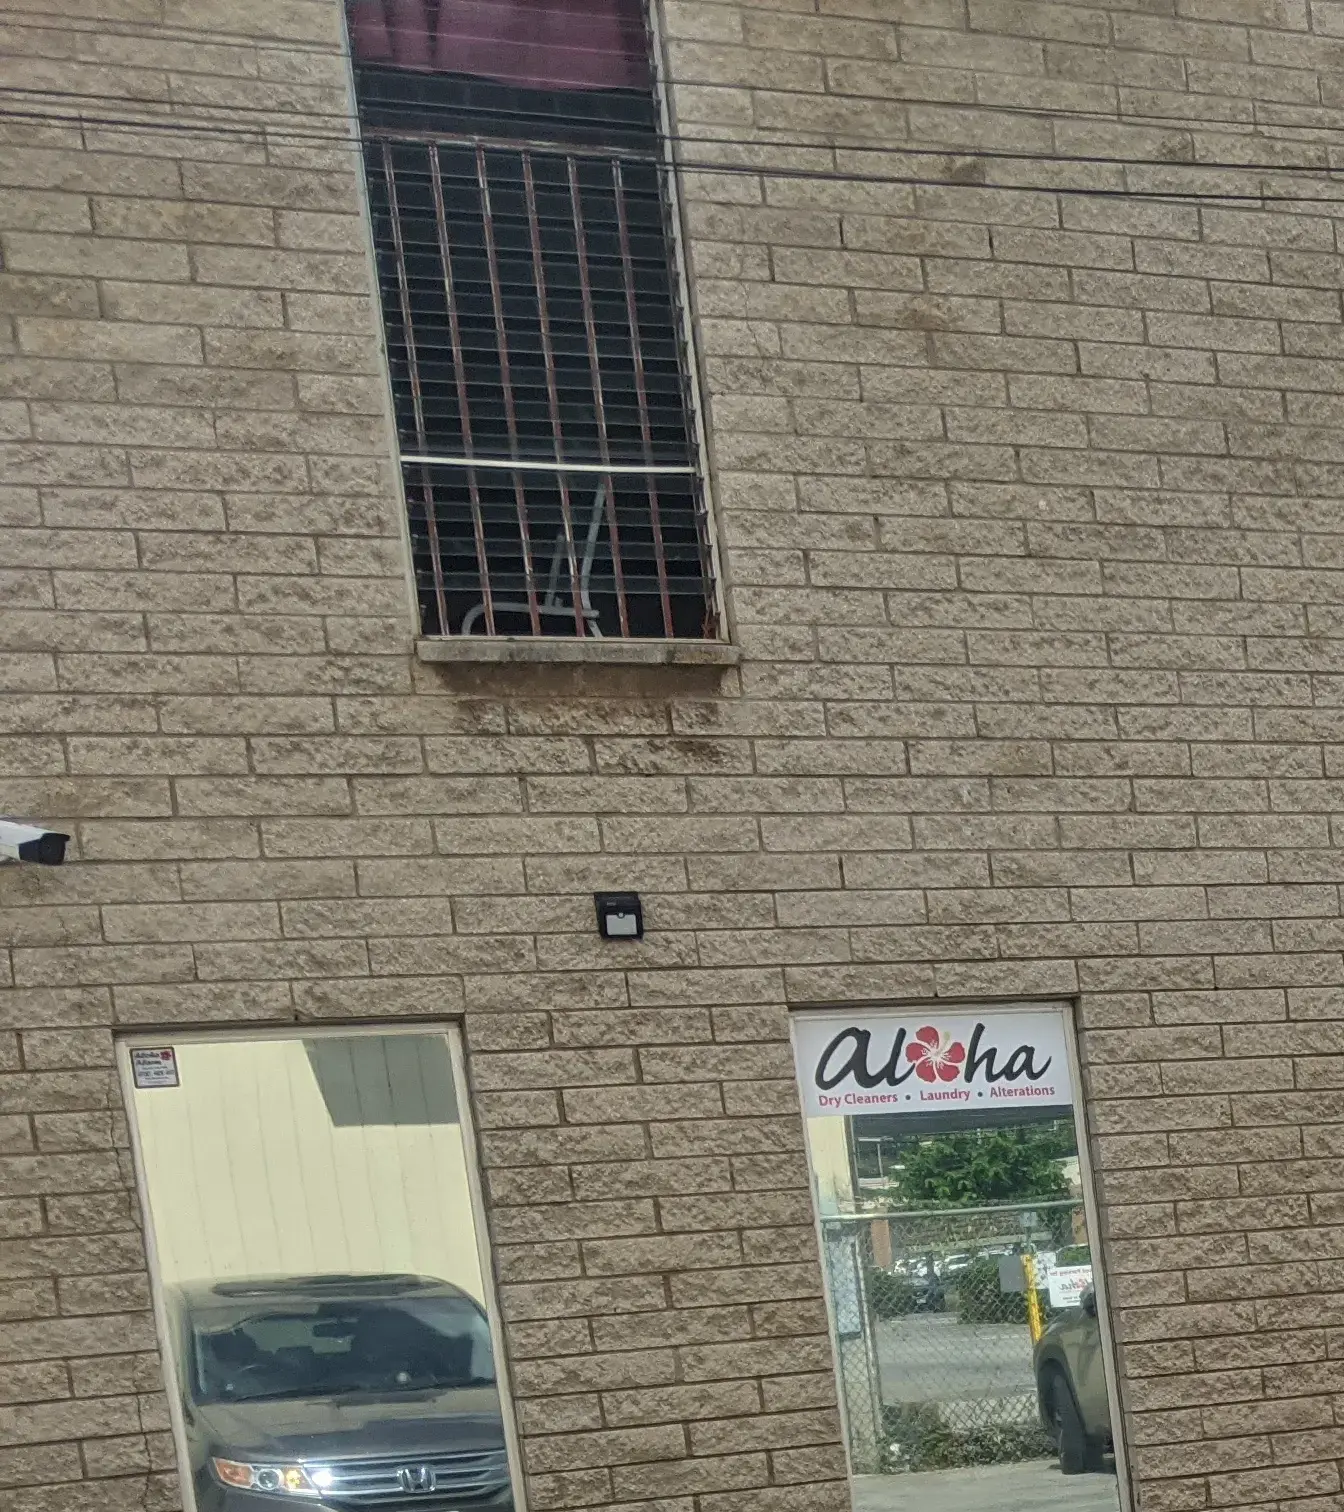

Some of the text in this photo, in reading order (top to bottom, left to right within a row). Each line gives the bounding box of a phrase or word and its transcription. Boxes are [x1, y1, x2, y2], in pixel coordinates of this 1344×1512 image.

[818, 1084, 1056, 1108] Dry Cleaners Laundry Alterations
